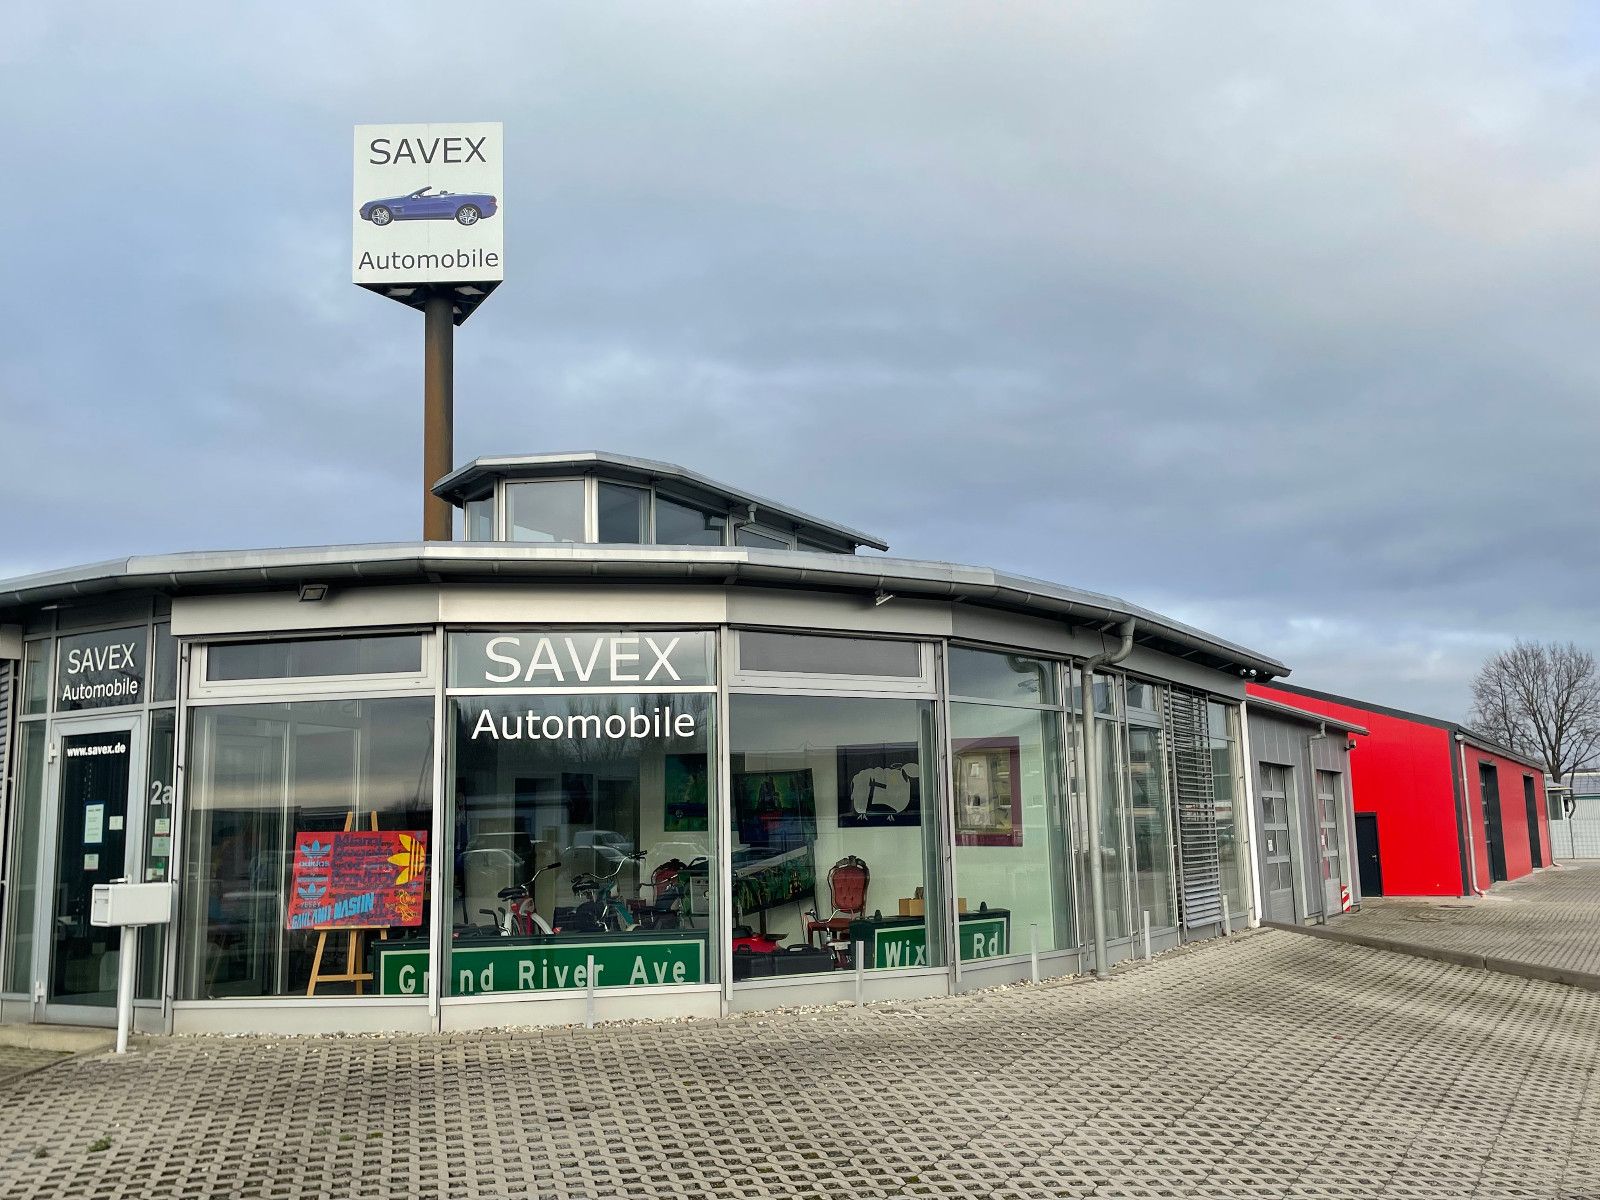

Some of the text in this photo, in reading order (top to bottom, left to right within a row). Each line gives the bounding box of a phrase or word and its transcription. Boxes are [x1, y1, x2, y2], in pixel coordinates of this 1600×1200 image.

[369, 136, 487, 165] SAVEX
[358, 248, 499, 270] Automobile
[67, 642, 136, 675] SAVEX
[485, 637, 681, 682] SAVEX
[62, 677, 138, 701] Automobile
[471, 706, 695, 740] Automobile
[67, 741, 126, 757] www.savex.de
[150, 780, 173, 805] 2a
[884, 931, 999, 968] Wix Rd
[399, 955, 686, 994] Grnd River Ave
